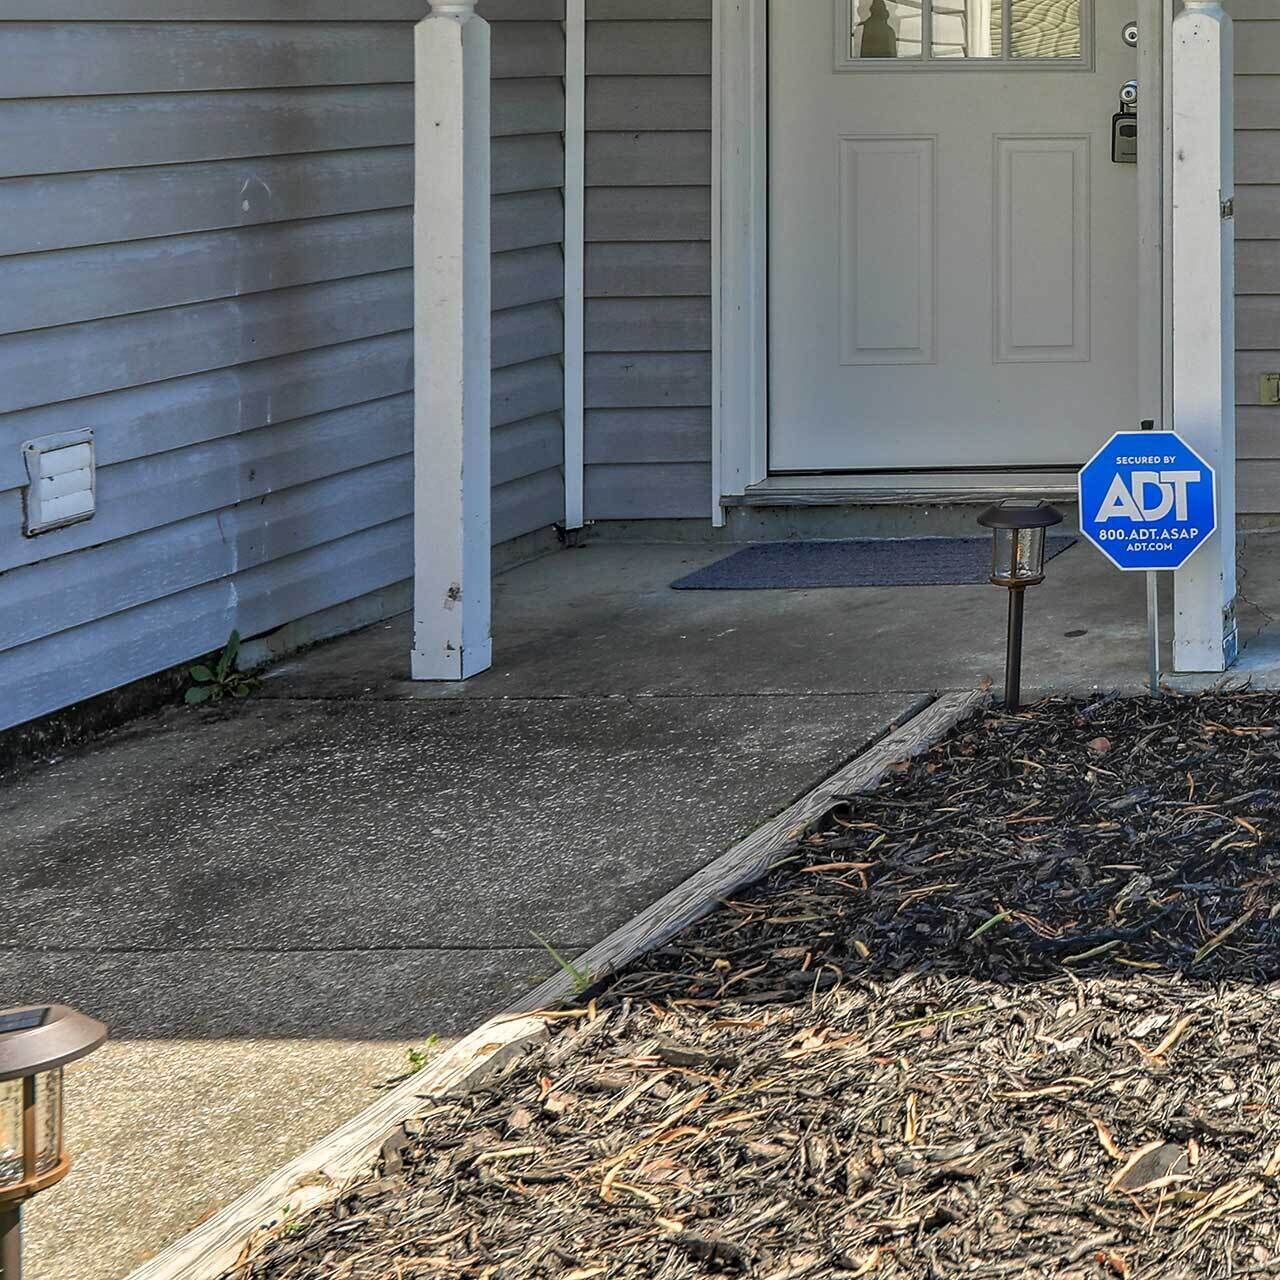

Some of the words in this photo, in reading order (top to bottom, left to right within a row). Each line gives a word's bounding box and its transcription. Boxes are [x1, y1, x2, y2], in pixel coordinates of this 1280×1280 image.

[1116, 456, 1161, 464] SECURED
[1163, 456, 1176, 464] BY
[1094, 470, 1201, 523] ADT
[1099, 528, 1199, 541] 800.ADT.ASAP
[1126, 543, 1173, 552] ADT.COM
